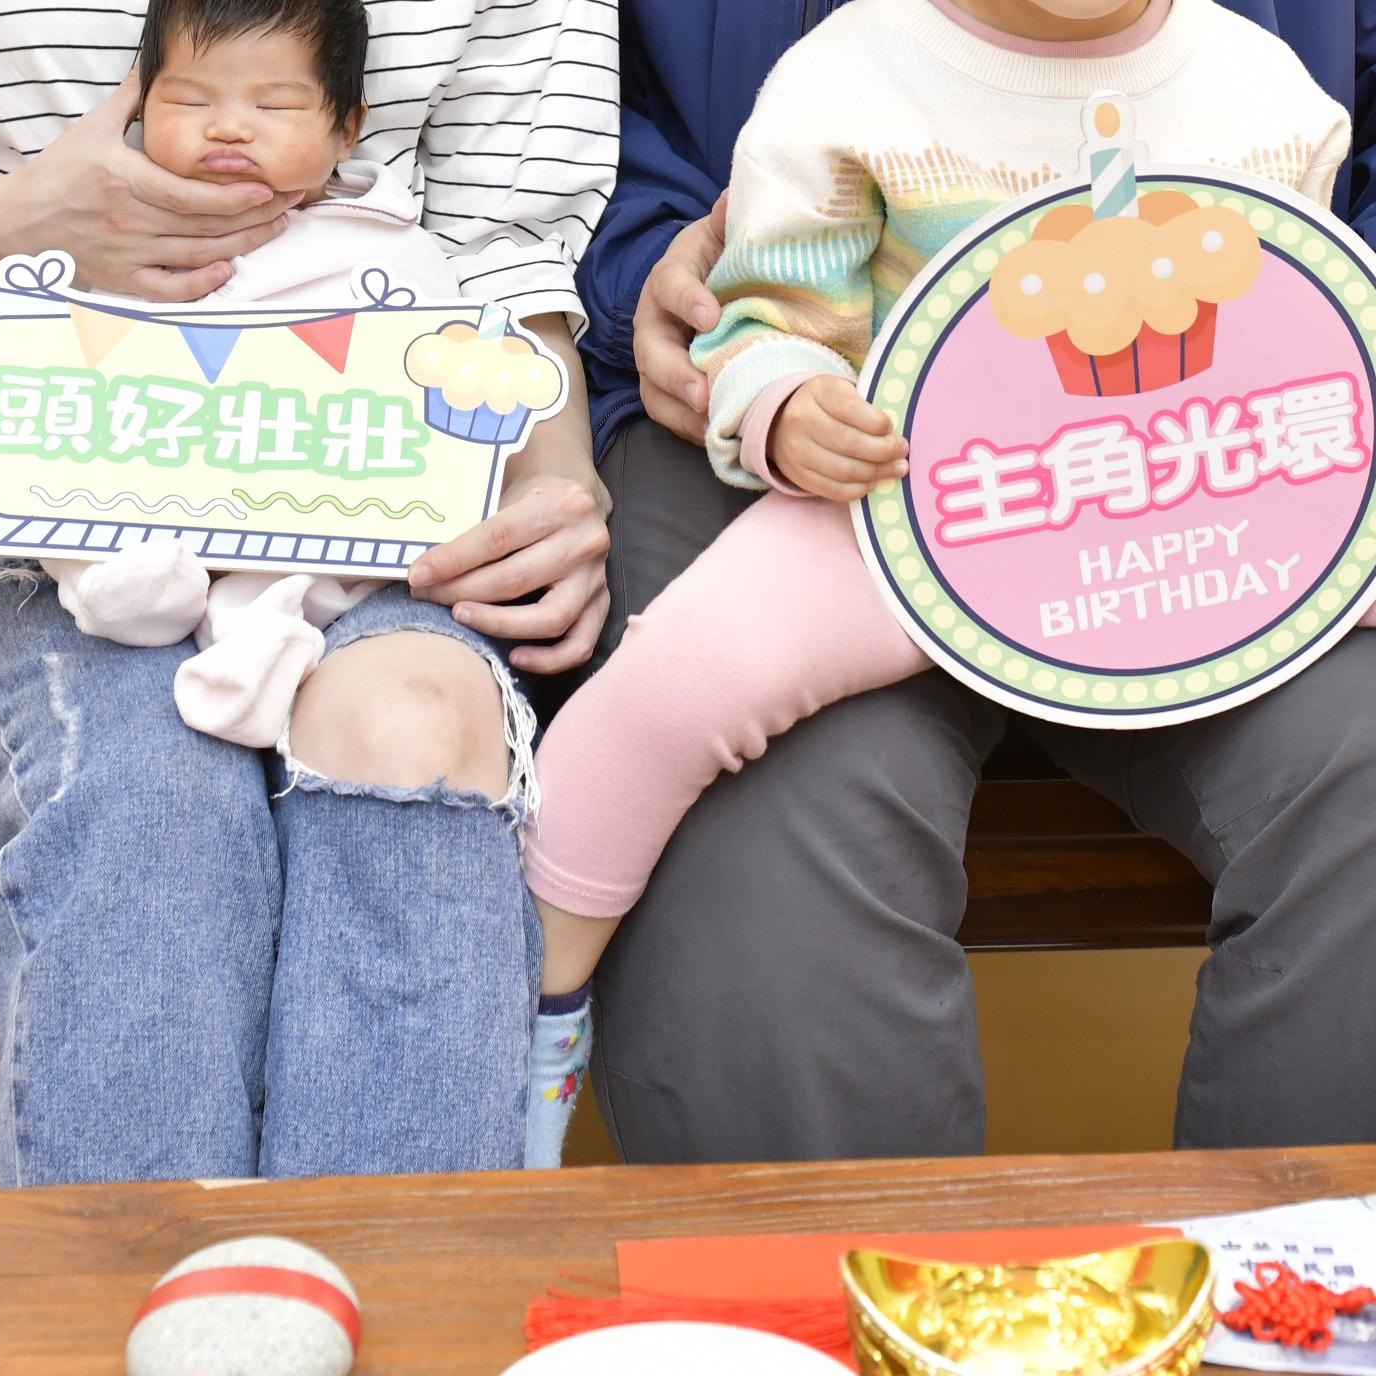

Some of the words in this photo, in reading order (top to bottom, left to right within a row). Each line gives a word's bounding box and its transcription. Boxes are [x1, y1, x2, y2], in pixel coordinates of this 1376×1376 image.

[934, 376, 1364, 543] 主角光環
[1078, 520, 1251, 586] HAPPY
[1039, 554, 1301, 638] BIRTHDAY
